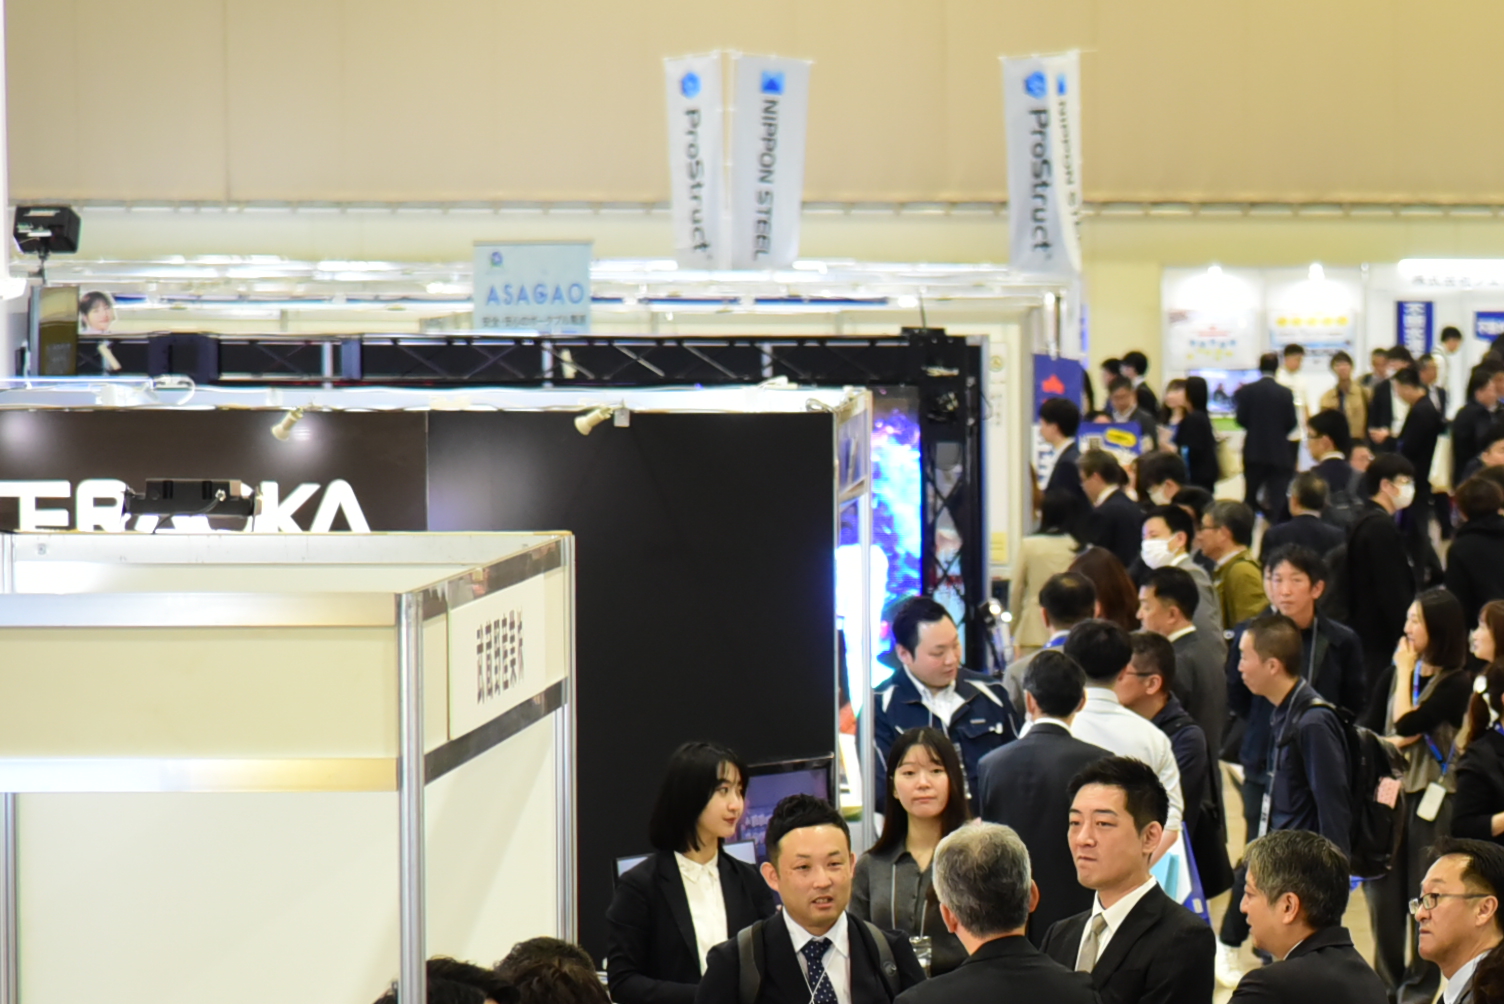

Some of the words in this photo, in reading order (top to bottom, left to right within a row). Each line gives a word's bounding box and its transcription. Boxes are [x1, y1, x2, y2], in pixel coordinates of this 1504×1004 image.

[685, 108, 710, 253] ProStruct
[758, 99, 780, 184] NIPPON
[1028, 108, 1052, 253] ProStruct
[753, 190, 774, 261] STEEL
[486, 283, 585, 306] ASAGAO
